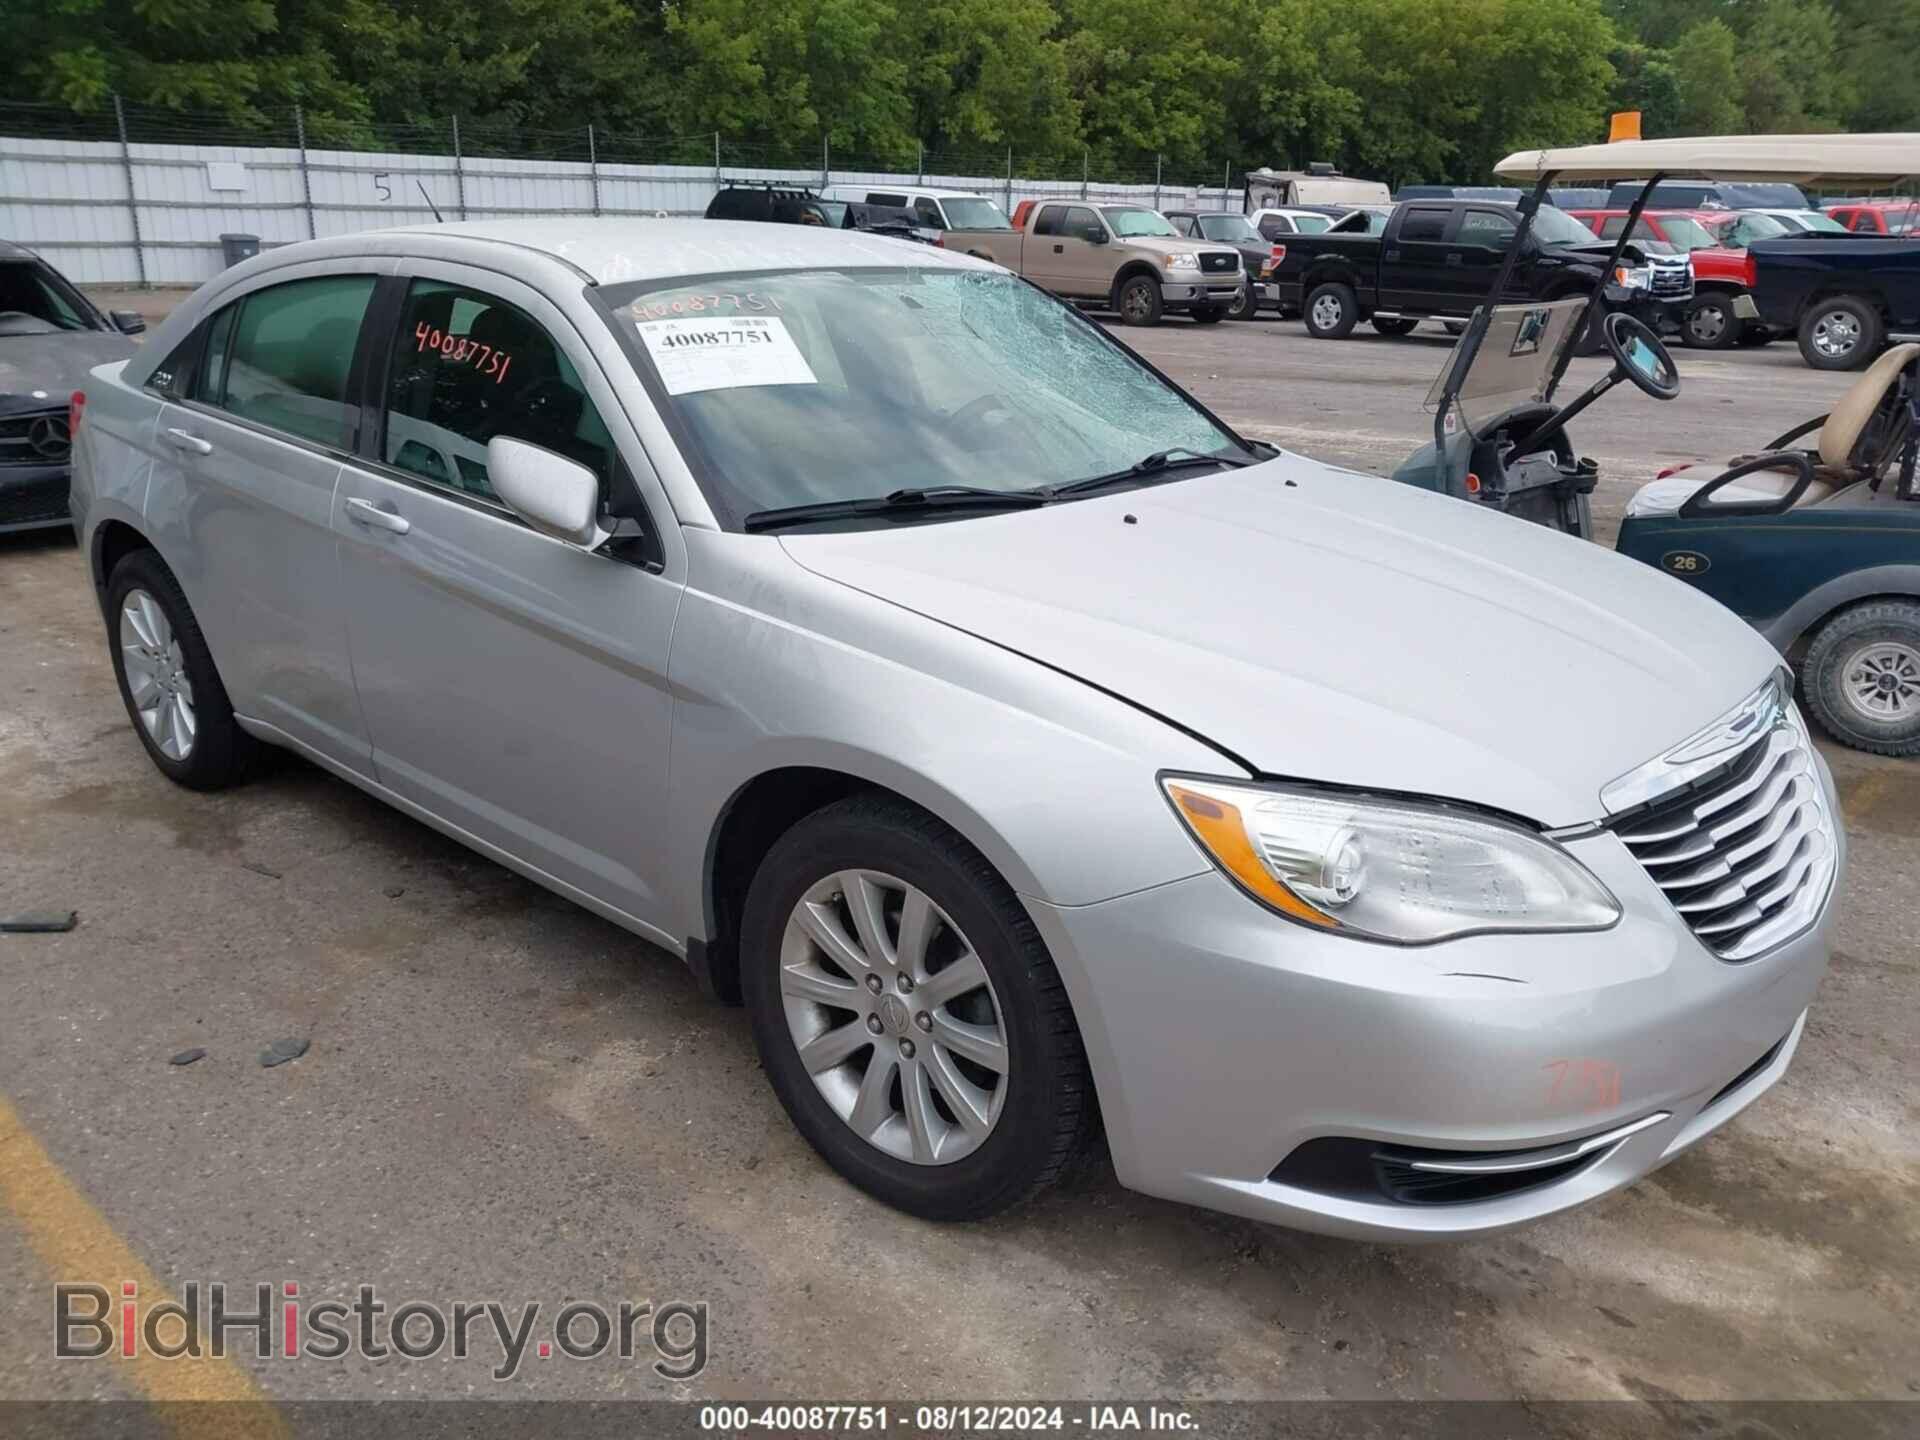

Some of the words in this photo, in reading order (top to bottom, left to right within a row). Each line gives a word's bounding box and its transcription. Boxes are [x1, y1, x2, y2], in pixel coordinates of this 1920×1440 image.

[374, 172, 391, 201] 5
[632, 294, 782, 320] 40087751
[661, 330, 773, 348] 40087751
[416, 321, 511, 384] 40087751
[1673, 556, 1697, 570] 26
